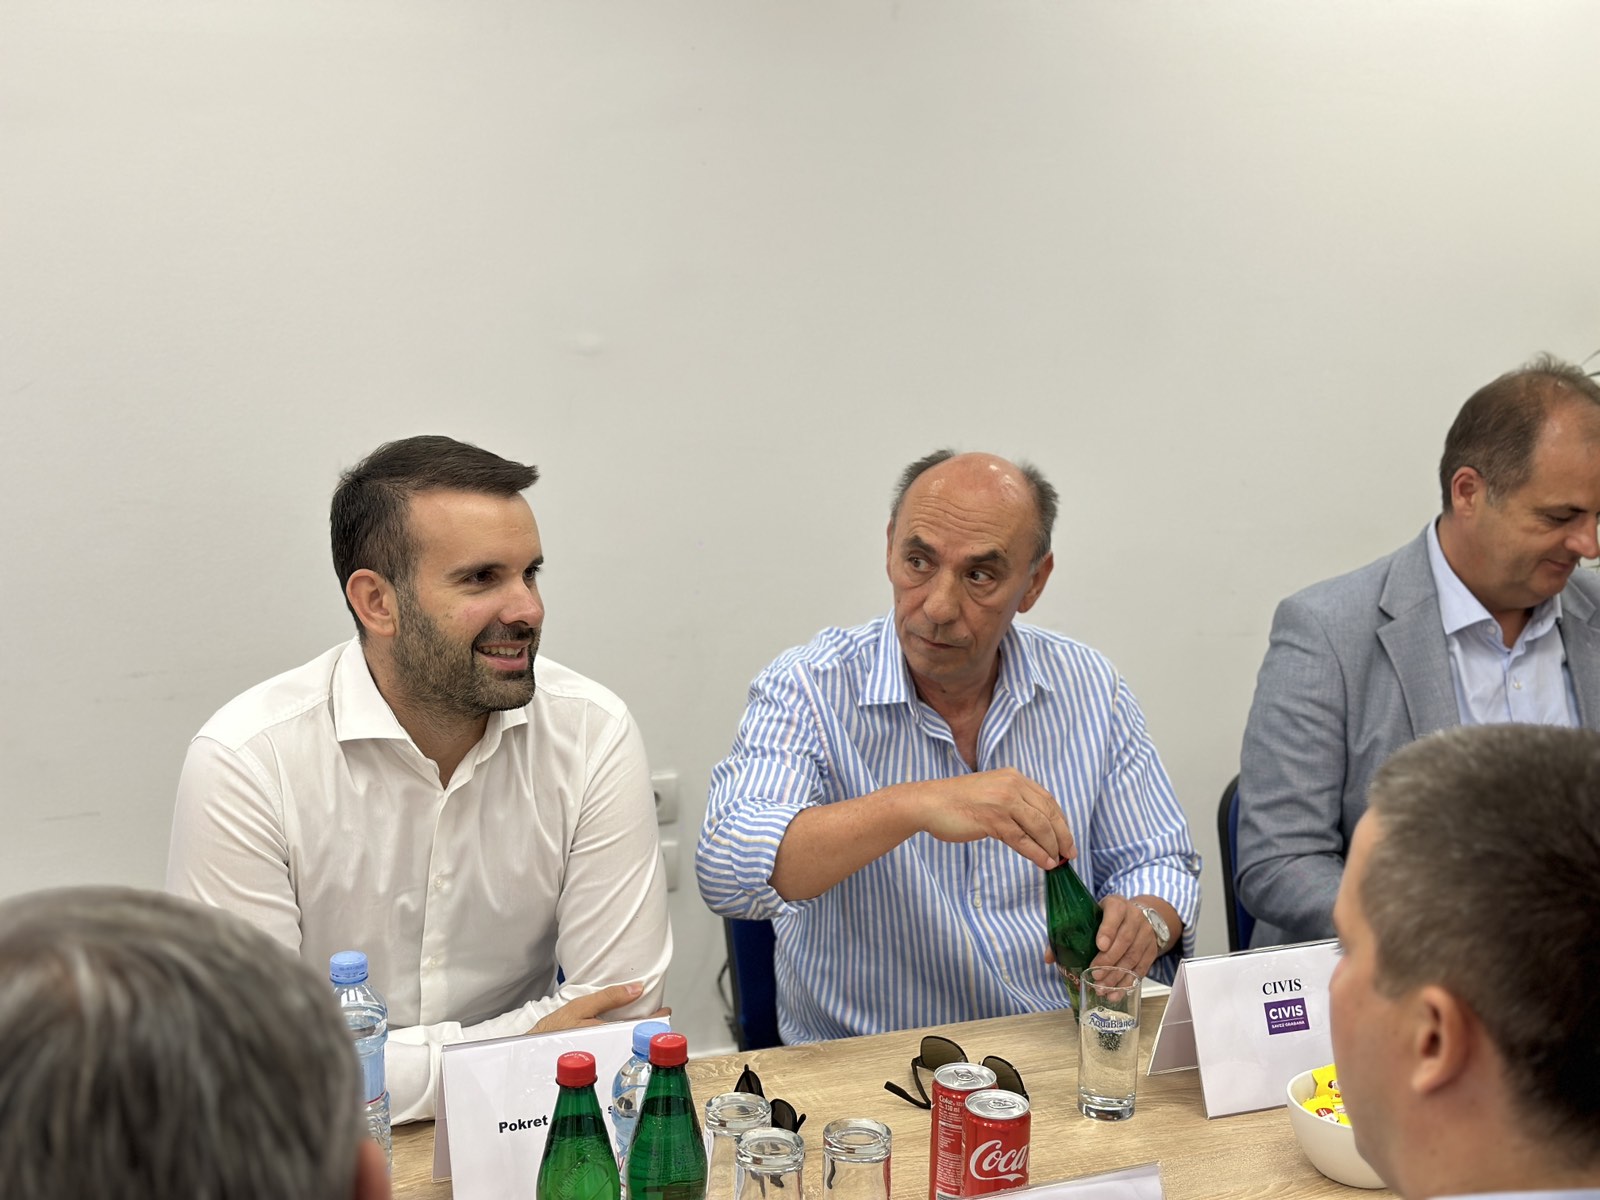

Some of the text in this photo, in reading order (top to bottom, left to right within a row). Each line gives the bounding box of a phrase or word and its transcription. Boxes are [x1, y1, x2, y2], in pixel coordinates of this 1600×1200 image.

[1262, 978, 1302, 995] CIVIS
[1269, 1004, 1304, 1020] CIVIS
[498, 1114, 549, 1134] Pokret
[969, 1139, 1029, 1182] Coca
